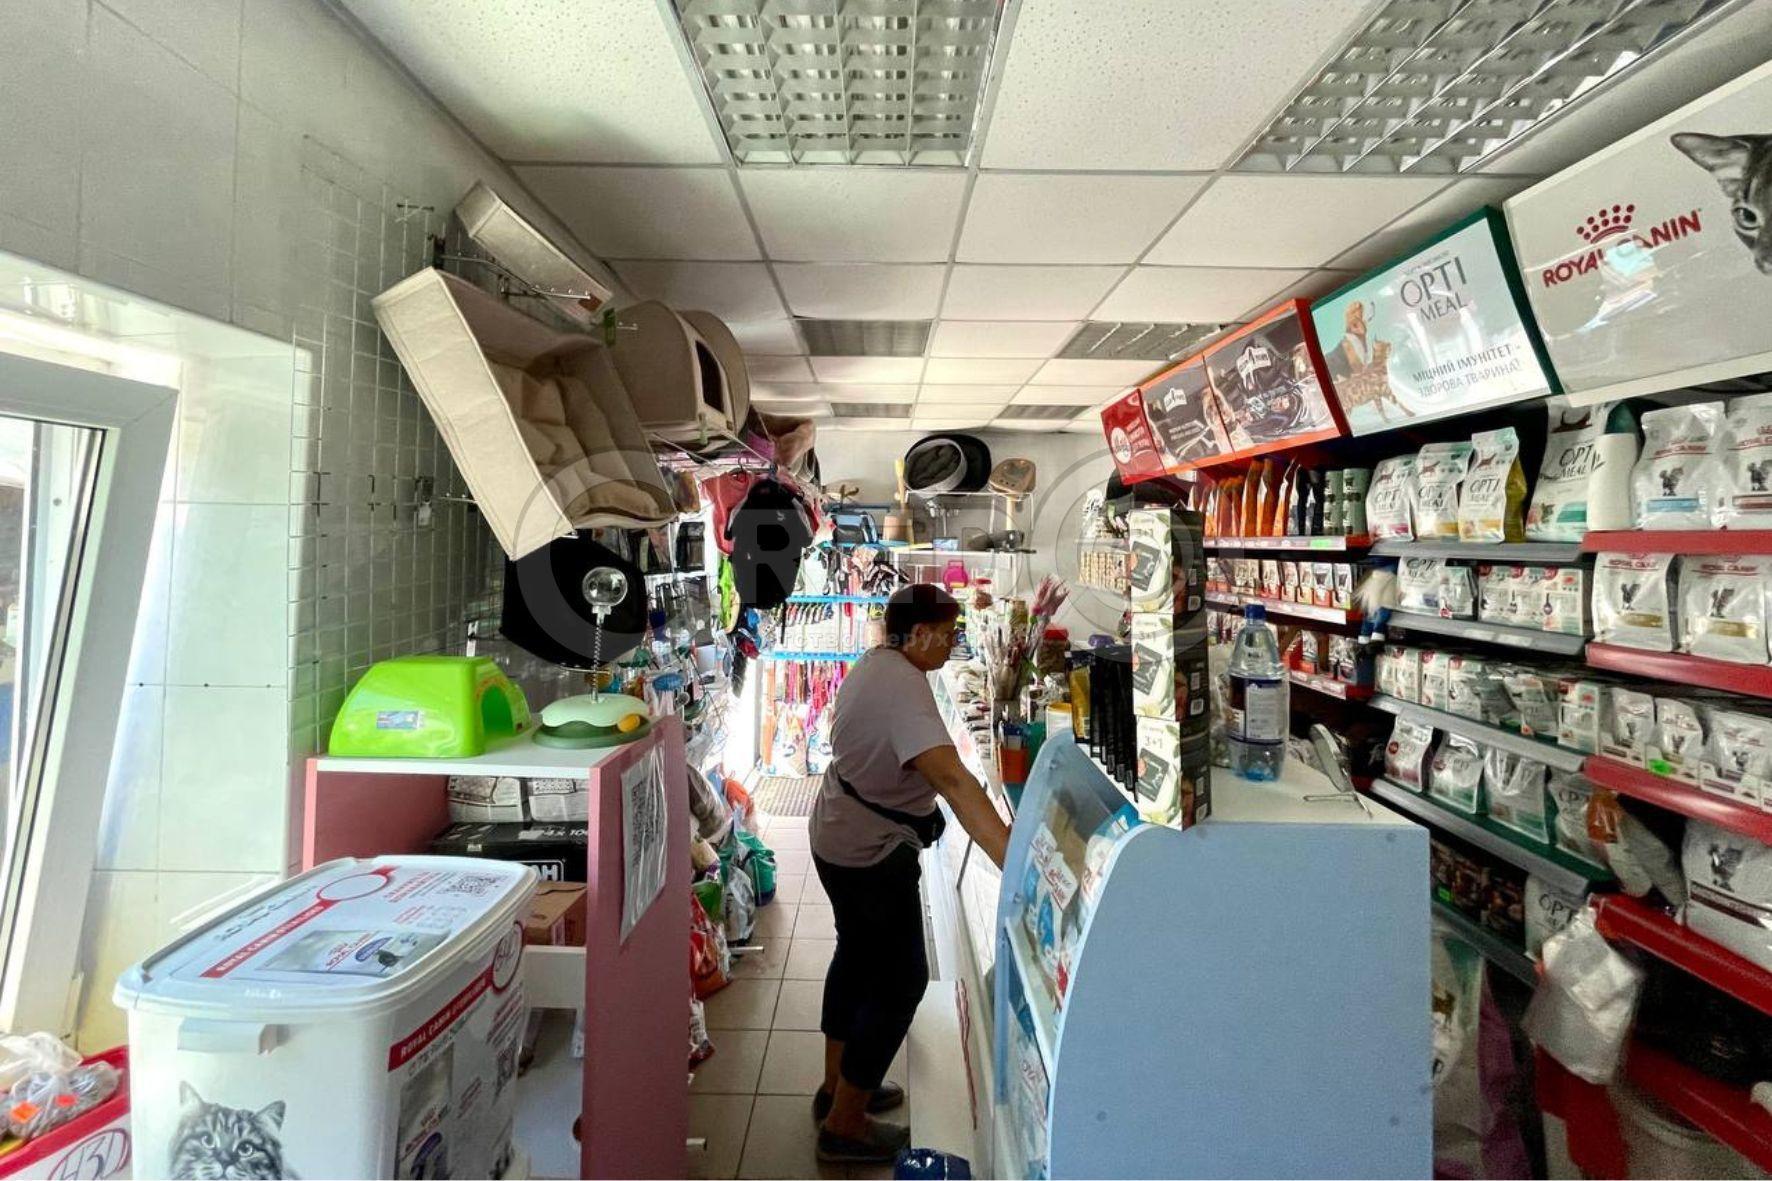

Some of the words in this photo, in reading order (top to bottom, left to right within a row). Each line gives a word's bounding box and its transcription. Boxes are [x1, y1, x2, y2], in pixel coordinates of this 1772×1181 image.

[1400, 256, 1467, 308] OPTI
[1420, 292, 1469, 321] MEAL
[1413, 361, 1455, 382] МІЦНИЙ
[1457, 344, 1512, 370] ІМУНІТЕТ
